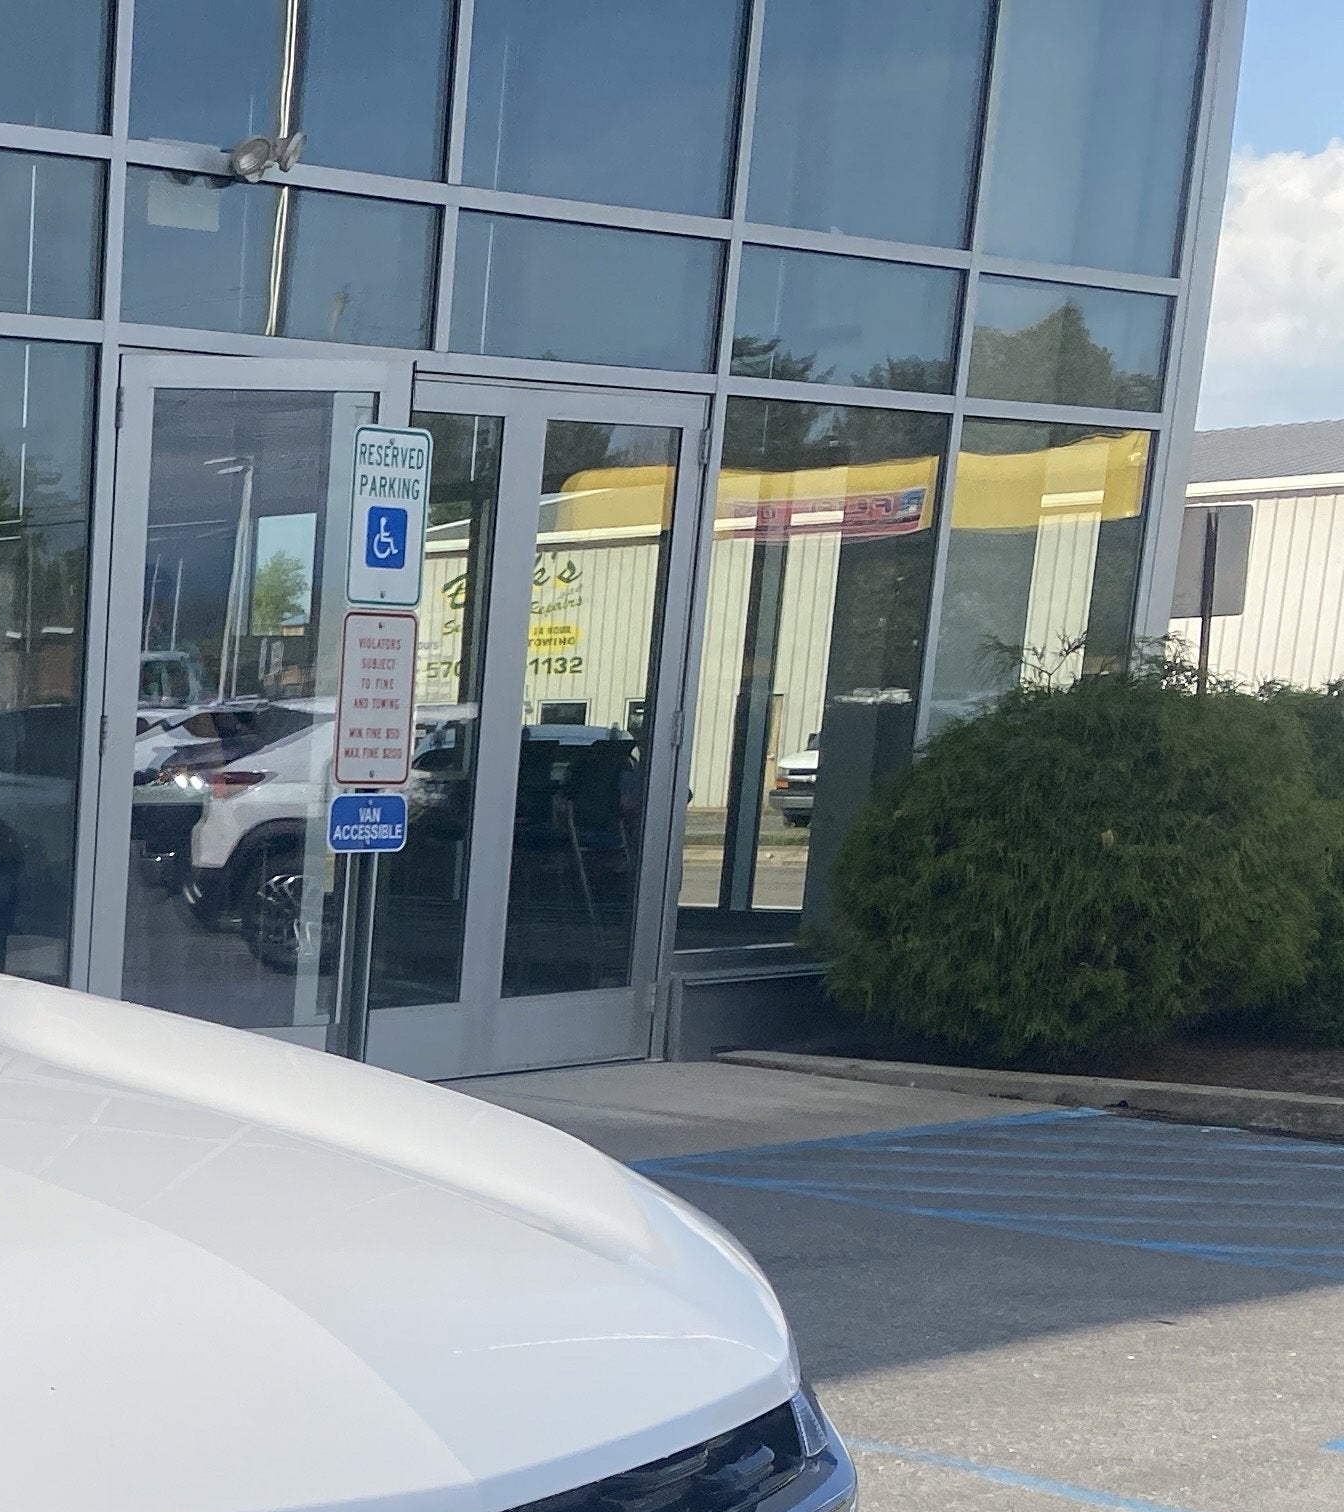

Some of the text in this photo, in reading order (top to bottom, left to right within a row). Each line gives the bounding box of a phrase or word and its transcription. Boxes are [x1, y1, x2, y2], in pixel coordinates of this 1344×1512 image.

[359, 443, 424, 470] RESERVED
[359, 474, 420, 500] PARKING
[358, 638, 401, 651] VIOLATORS
[361, 657, 396, 670] SUBJECT
[528, 656, 583, 675] 1132
[361, 677, 395, 690] TO FINE
[353, 697, 401, 710] AND TOWING
[365, 727, 383, 739] FINE
[362, 747, 379, 759] FINE
[358, 806, 382, 823] VAN
[333, 823, 403, 841] ACCESSIBLE
